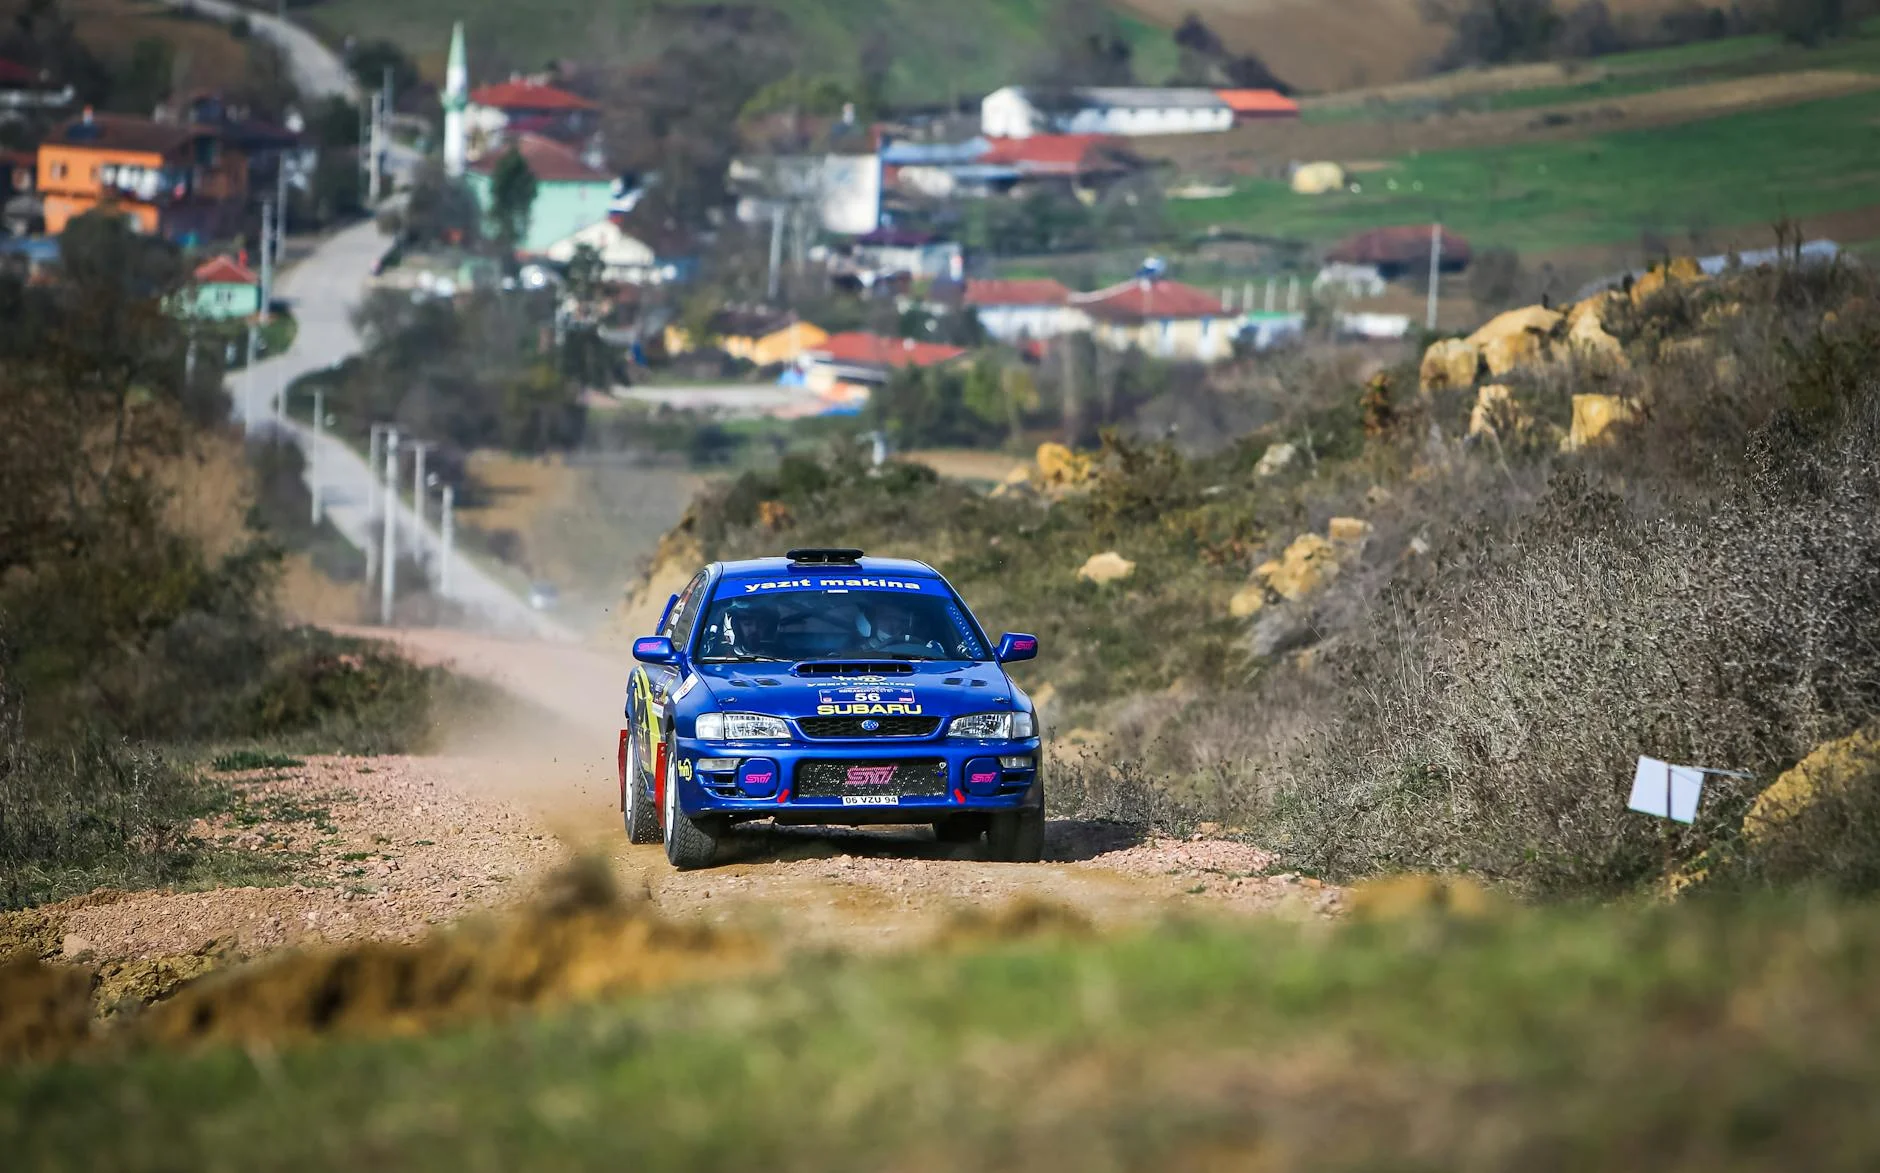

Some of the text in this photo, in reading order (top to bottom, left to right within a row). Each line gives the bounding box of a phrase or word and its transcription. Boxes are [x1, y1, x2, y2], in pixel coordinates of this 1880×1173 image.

[820, 578, 920, 589] makina
[854, 693, 881, 701] 56
[817, 703, 922, 715] SUBARU
[845, 796, 897, 804] 06 VZU 94
